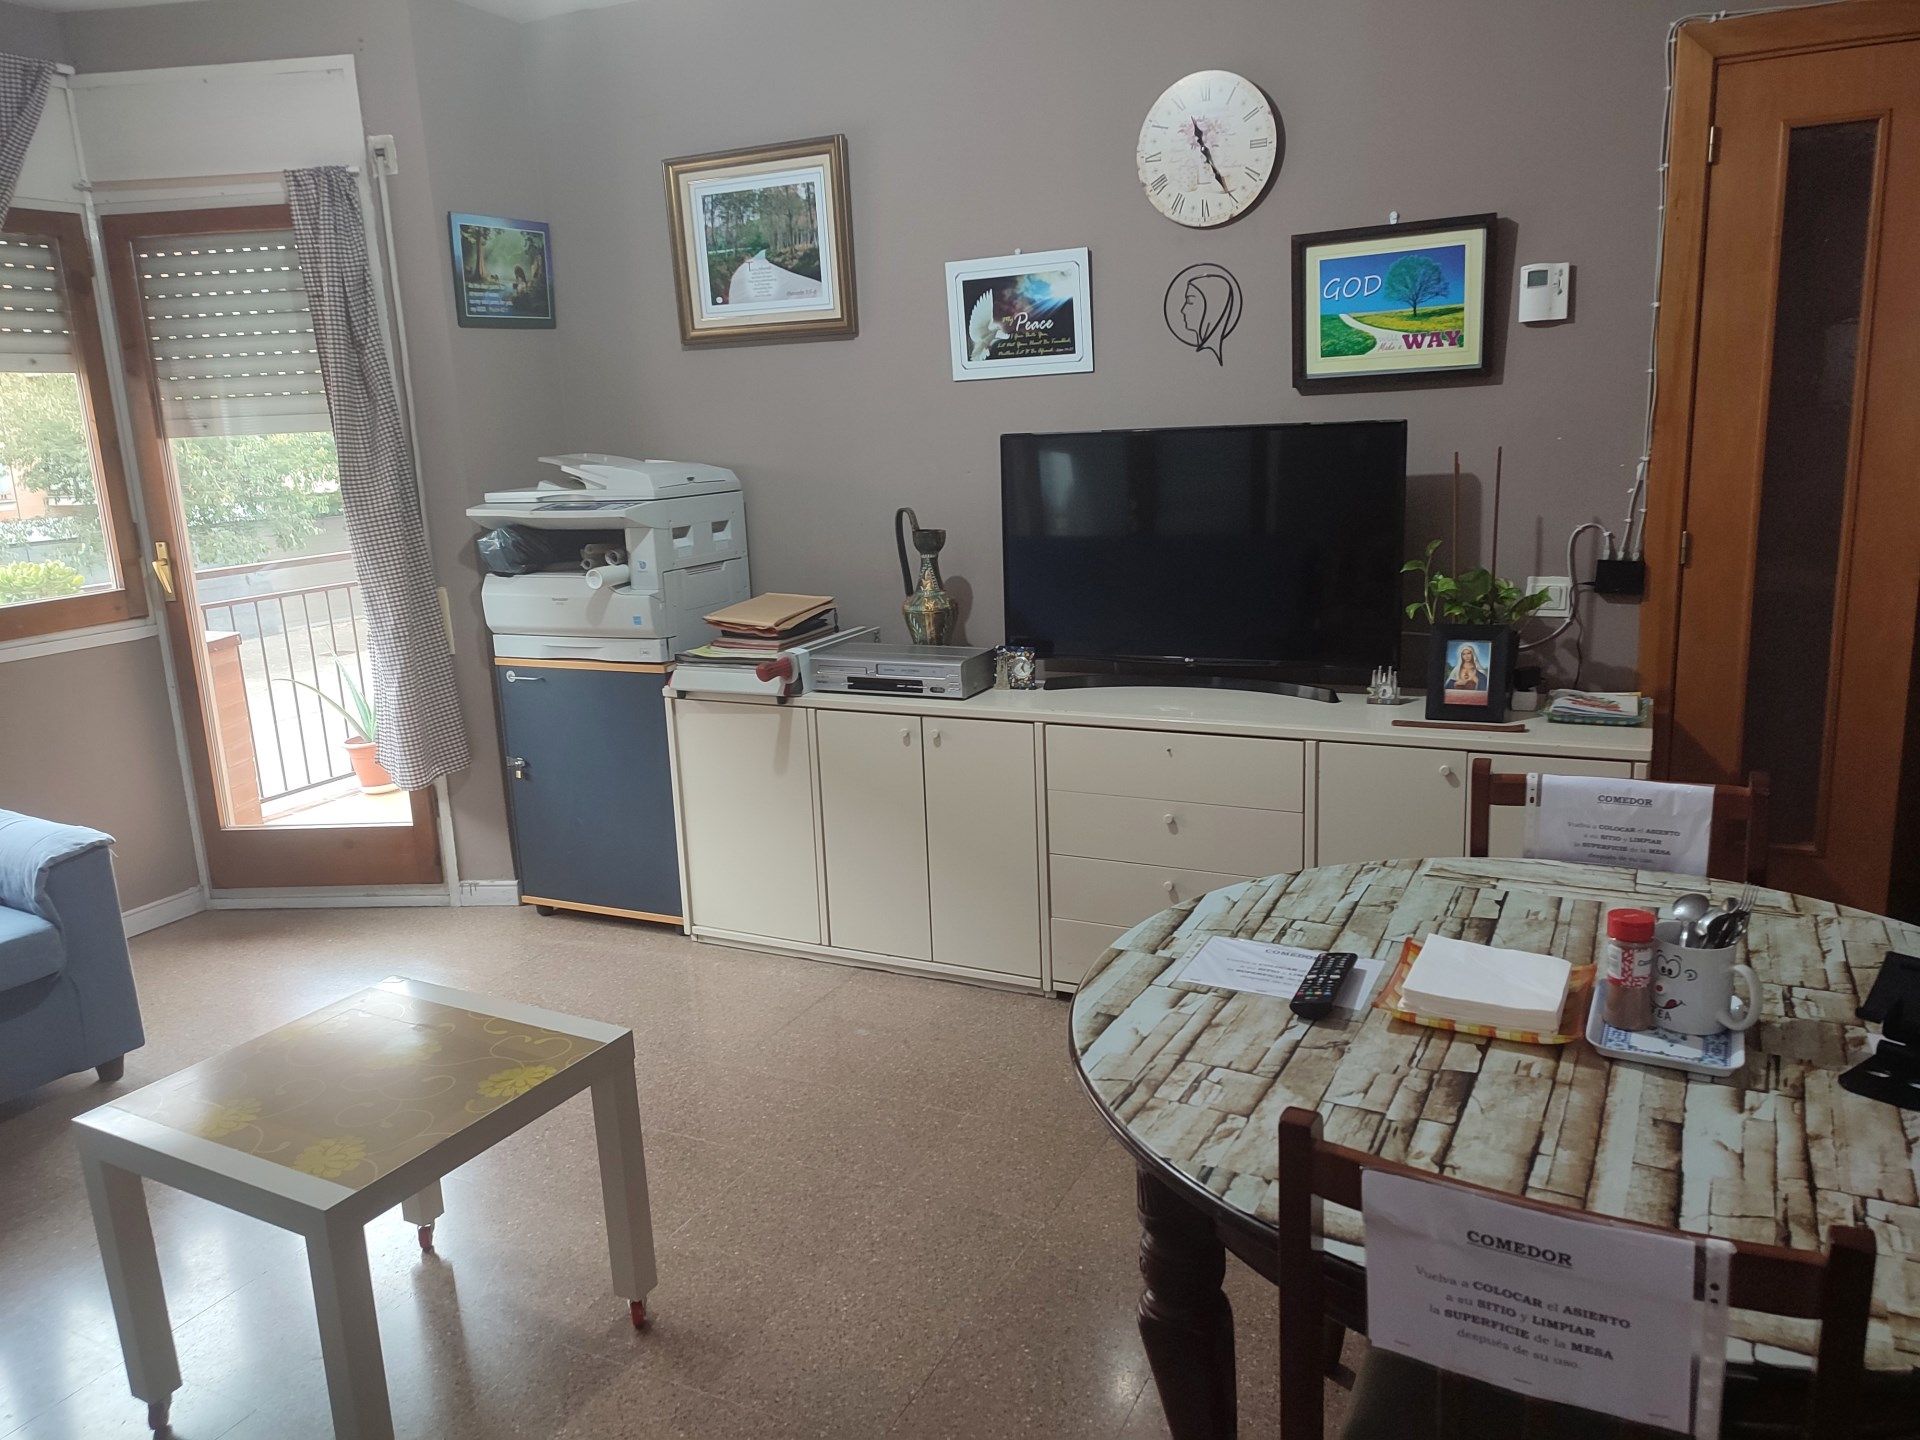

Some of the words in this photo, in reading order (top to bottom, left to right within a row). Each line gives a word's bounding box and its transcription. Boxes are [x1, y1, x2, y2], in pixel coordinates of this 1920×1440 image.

[1323, 274, 1381, 301] GOD
[1014, 312, 1054, 331] Peace
[1402, 330, 1461, 349] WAY
[1597, 794, 1653, 806] COMEDOR
[1599, 824, 1636, 832] COLOCAR
[1652, 1008, 1671, 1021] EA
[1466, 1229, 1574, 1267] COMEDOR
[1415, 1265, 1457, 1286] Vuelva
[1472, 1281, 1543, 1308] COLOCAR
[1547, 1302, 1559, 1312] el
[1563, 1305, 1631, 1329] ASIENTO
[1446, 1294, 1453, 1302] a
[1458, 1297, 1473, 1306] su
[1477, 1299, 1517, 1318] SITIO
[1520, 1313, 1528, 1323] y
[1532, 1316, 1596, 1338] LIMPIAR
[1429, 1304, 1440, 1315] la
[1444, 1309, 1530, 1339] SUPERFICIE
[1534, 1334, 1549, 1345] de
[1554, 1338, 1566, 1350] la
[1571, 1342, 1614, 1360] MESA
[1456, 1328, 1510, 1351] después
[1513, 1344, 1528, 1355] de
[1533, 1353, 1549, 1362] su
